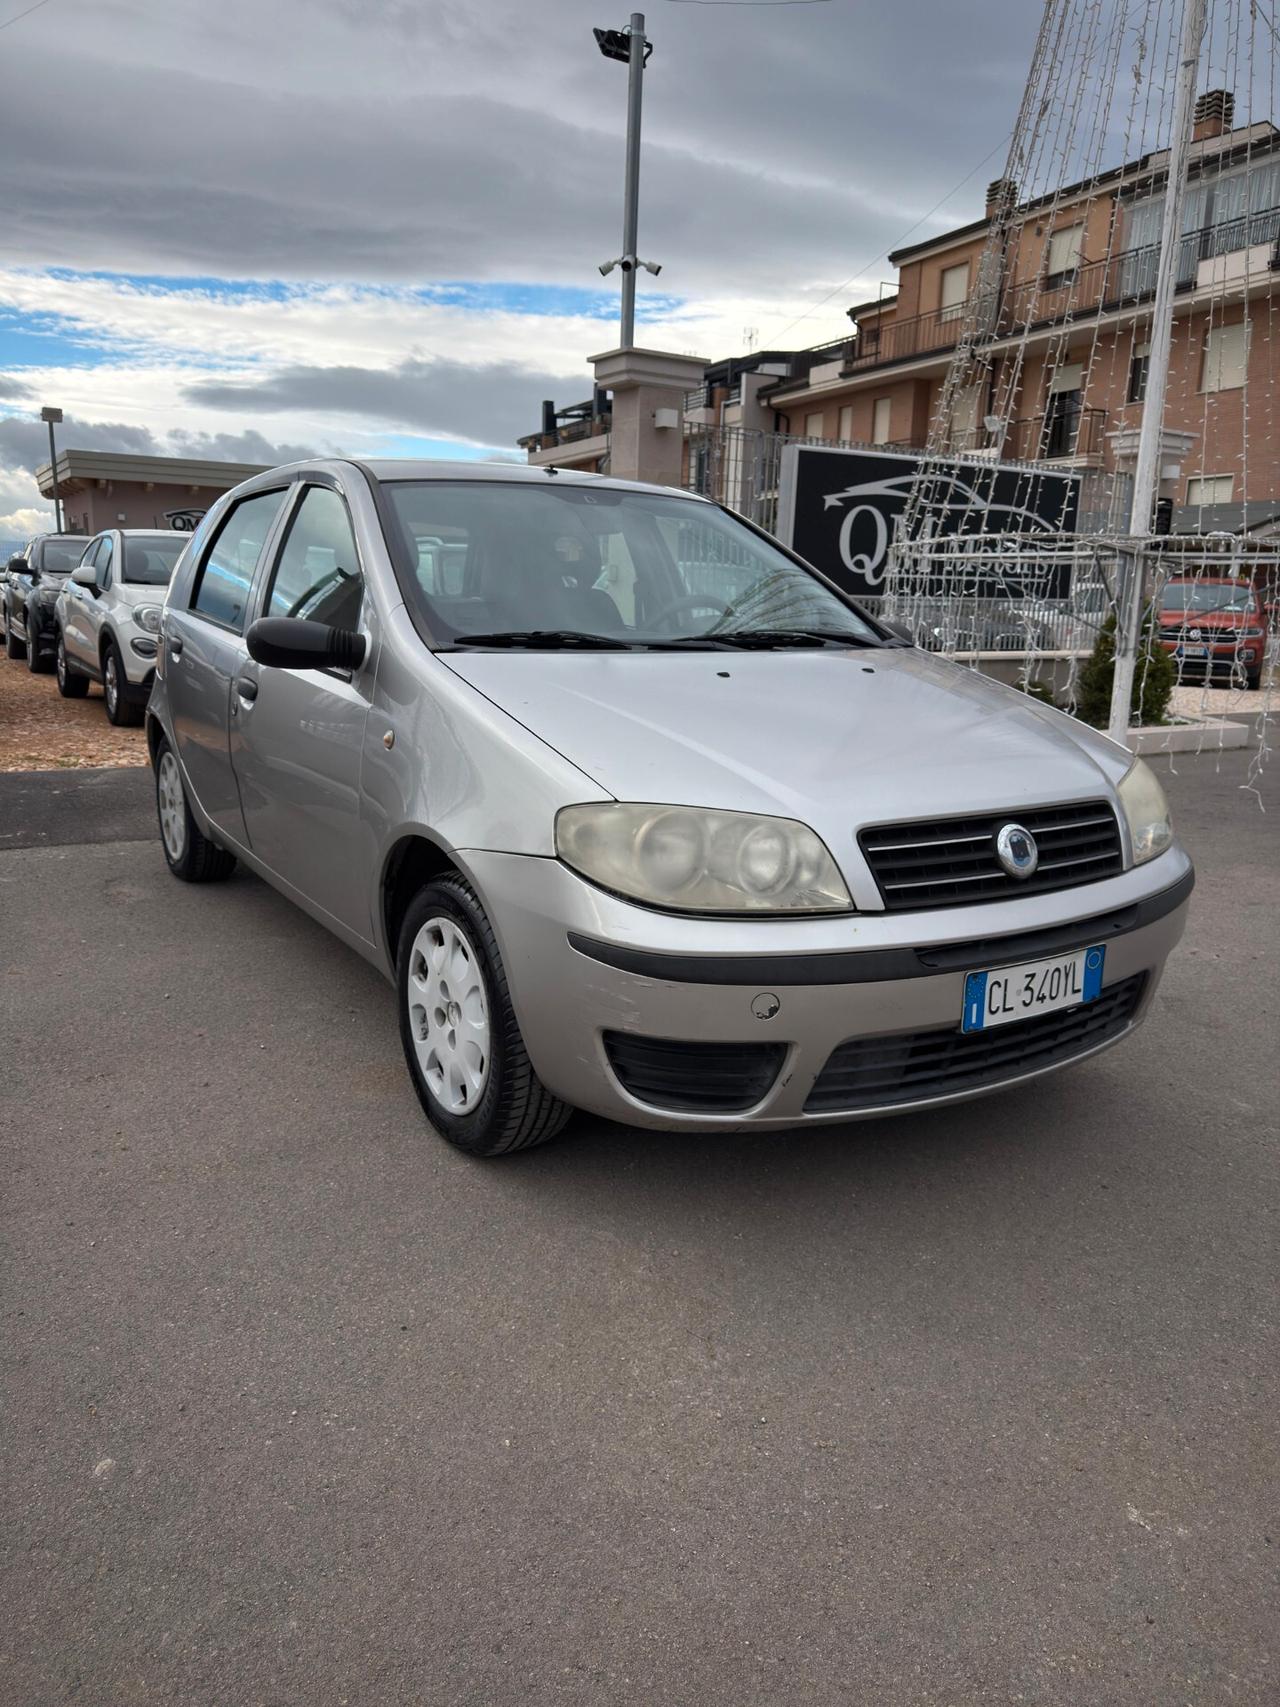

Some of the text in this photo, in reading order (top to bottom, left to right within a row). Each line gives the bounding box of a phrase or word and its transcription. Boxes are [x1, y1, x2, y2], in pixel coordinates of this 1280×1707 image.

[839, 504, 938, 586] QM
[988, 960, 1082, 1015] CL 340YL
